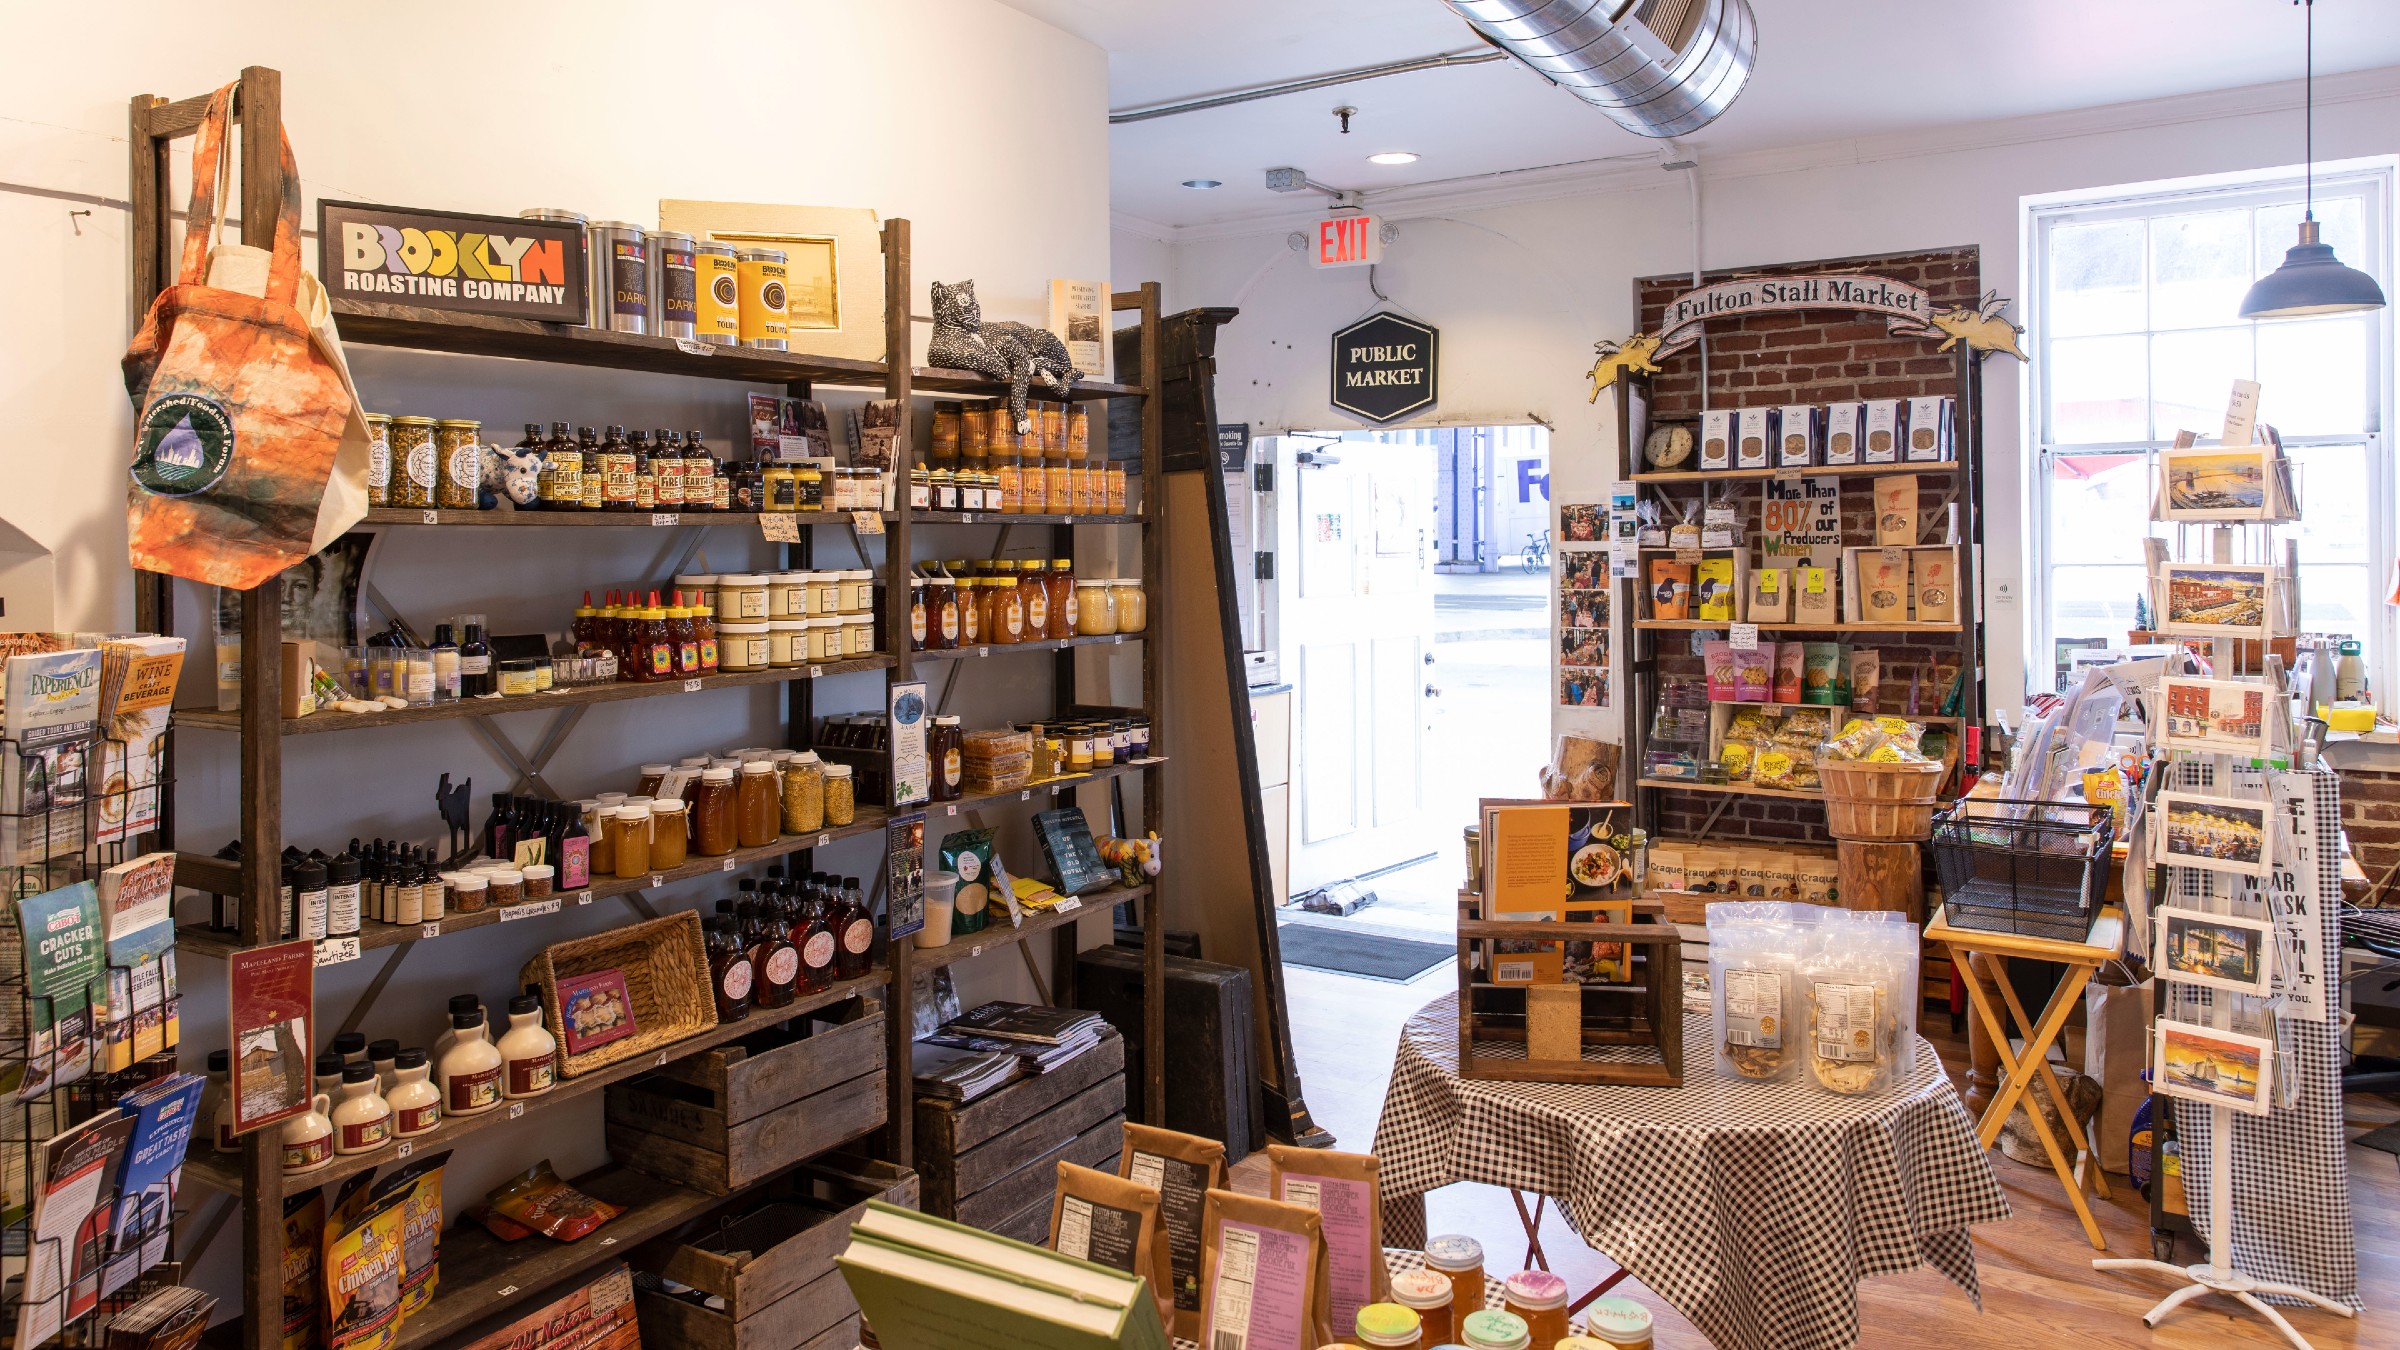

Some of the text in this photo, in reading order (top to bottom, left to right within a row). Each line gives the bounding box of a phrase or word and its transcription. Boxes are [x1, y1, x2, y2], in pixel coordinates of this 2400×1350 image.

[1320, 217, 1370, 263] EXIT
[342, 222, 565, 285] BROOKLYN
[343, 272, 565, 305] ROASTING COMPANY
[1674, 278, 1921, 326] Fulton Stall Market
[1350, 343, 1416, 364] PUBLIC
[1345, 367, 1424, 387] MARKET
[213, 438, 232, 474] Forum
[1800, 478, 1837, 500] Than
[1765, 500, 1834, 532] 80% of
[1815, 517, 1838, 532] our
[1762, 534, 1813, 557] Women
[1783, 530, 1840, 546] Producers
[0, 637, 28, 647] easons
[1711, 652, 1733, 660] BROOK
[31, 666, 94, 696] EXPERIENCE!
[136, 664, 173, 682] WINE
[123, 686, 170, 702] BEVERAGE
[139, 681, 160, 690] CRAFT
[27, 720, 91, 739] GUIDED TOURS AND EVENTS
[1650, 862, 1683, 875] Craque
[1719, 868, 1737, 878] que
[1740, 868, 1764, 878] Craq
[1765, 870, 1795, 882] Craqu
[1801, 872, 1839, 884] Craque
[2244, 871, 2295, 893] WAR
[40, 925, 94, 956] CRACKER
[314, 940, 356, 955] and $5
[55, 943, 83, 963] CUTS
[241, 951, 305, 969] MAPLELAND FARMS
[125, 975, 167, 996] CEESE FESTIVL
[149, 1116, 185, 1139] EXPERIENCE
[93, 1135, 126, 1157] MAPLE
[134, 1125, 190, 1164] GREAT TASTE
[1094, 1206, 1122, 1220] GLUTEN-FREE
[1322, 1203, 1358, 1214] COOKIE MIX
[283, 1253, 309, 1284] icken
[1259, 1255, 1295, 1269] COOKIE MIX
[339, 1257, 383, 1295] Chicken
[541, 1306, 592, 1344] Natura
